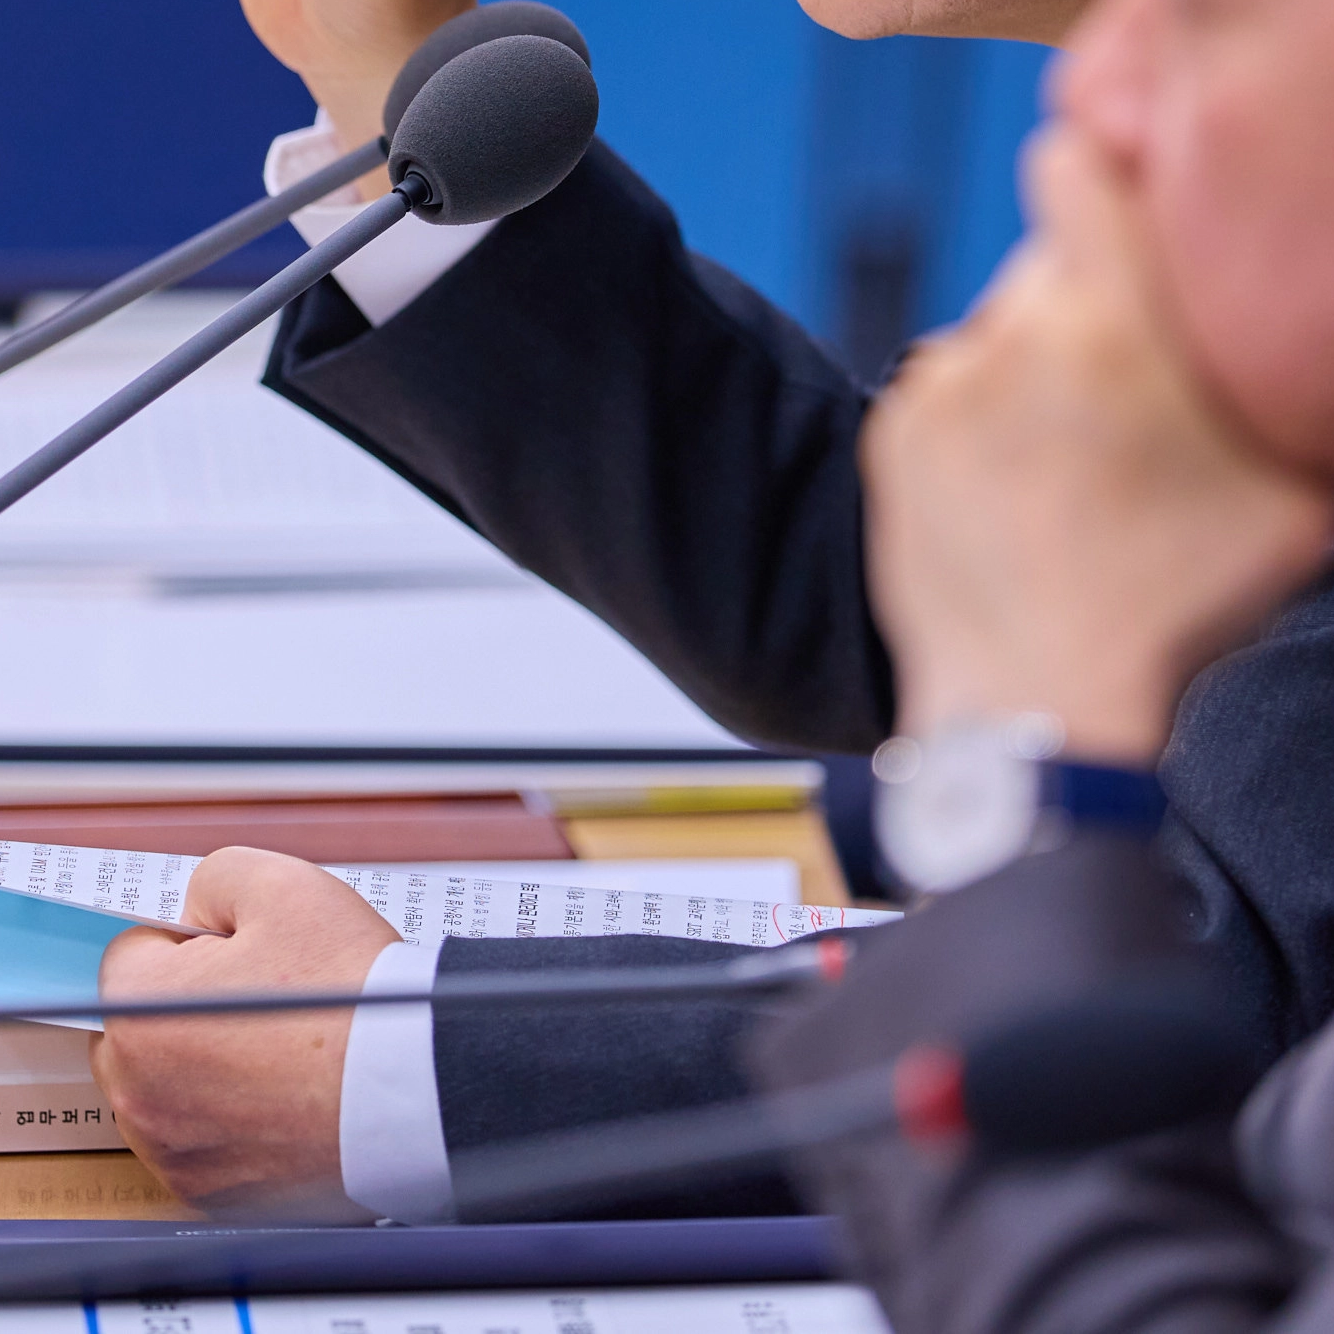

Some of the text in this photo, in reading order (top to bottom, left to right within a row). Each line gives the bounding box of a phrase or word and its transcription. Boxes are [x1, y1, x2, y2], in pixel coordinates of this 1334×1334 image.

[30, 858, 47, 874] UAM
[120, 887, 140, 912] 고속철도
[518, 893, 538, 917] 편리하고
[403, 906, 424, 935] 지반탐사
[443, 899, 464, 926] 공항시설
[686, 923, 702, 937] SRT
[16, 1107, 101, 1126] 업무보고
